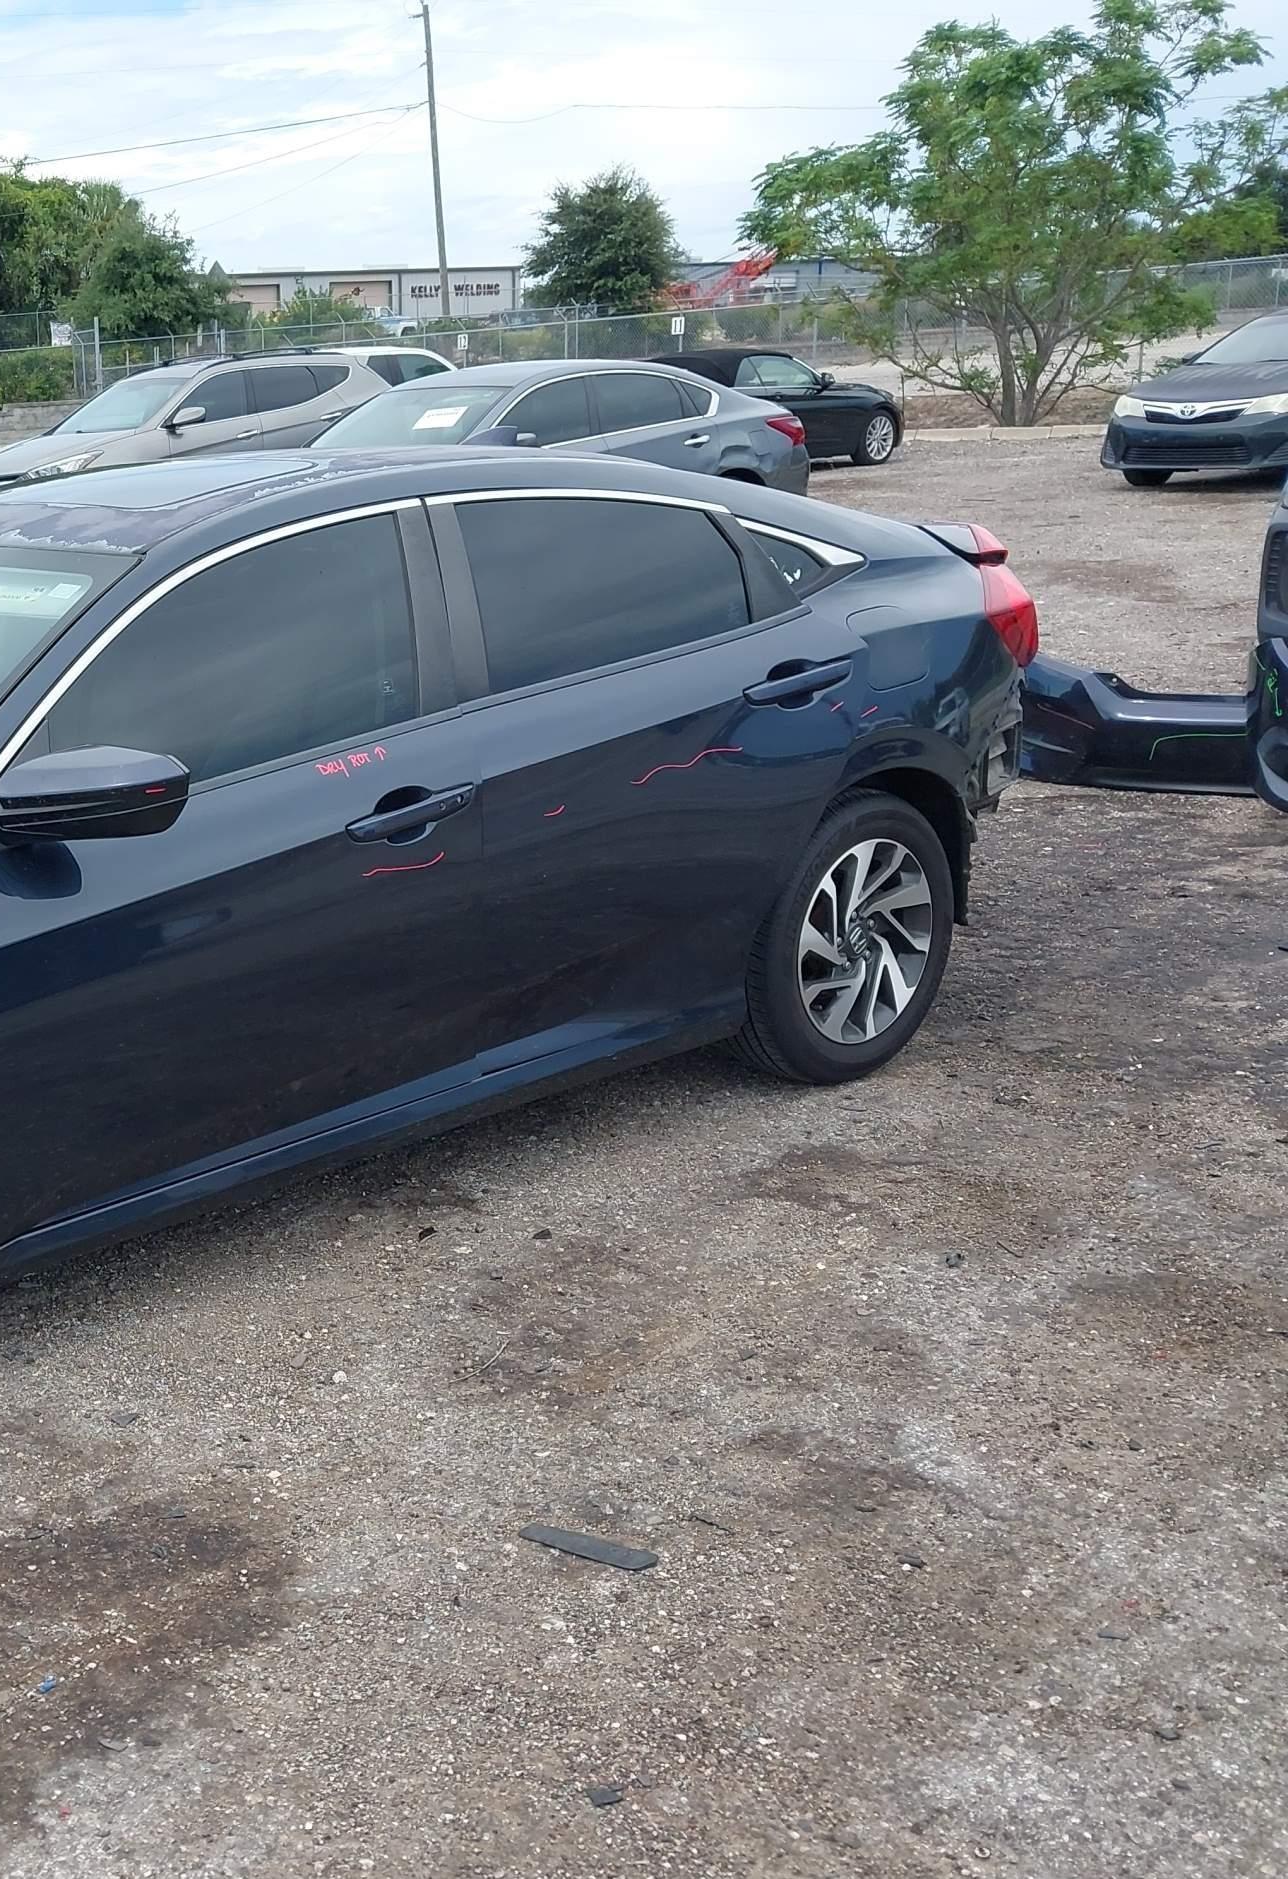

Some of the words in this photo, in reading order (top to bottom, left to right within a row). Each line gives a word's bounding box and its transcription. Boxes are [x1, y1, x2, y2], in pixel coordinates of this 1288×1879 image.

[410, 285, 441, 299] KELLY
[453, 283, 501, 297] WELDING
[315, 758, 350, 778] DRY
[347, 753, 372, 768] ROT
